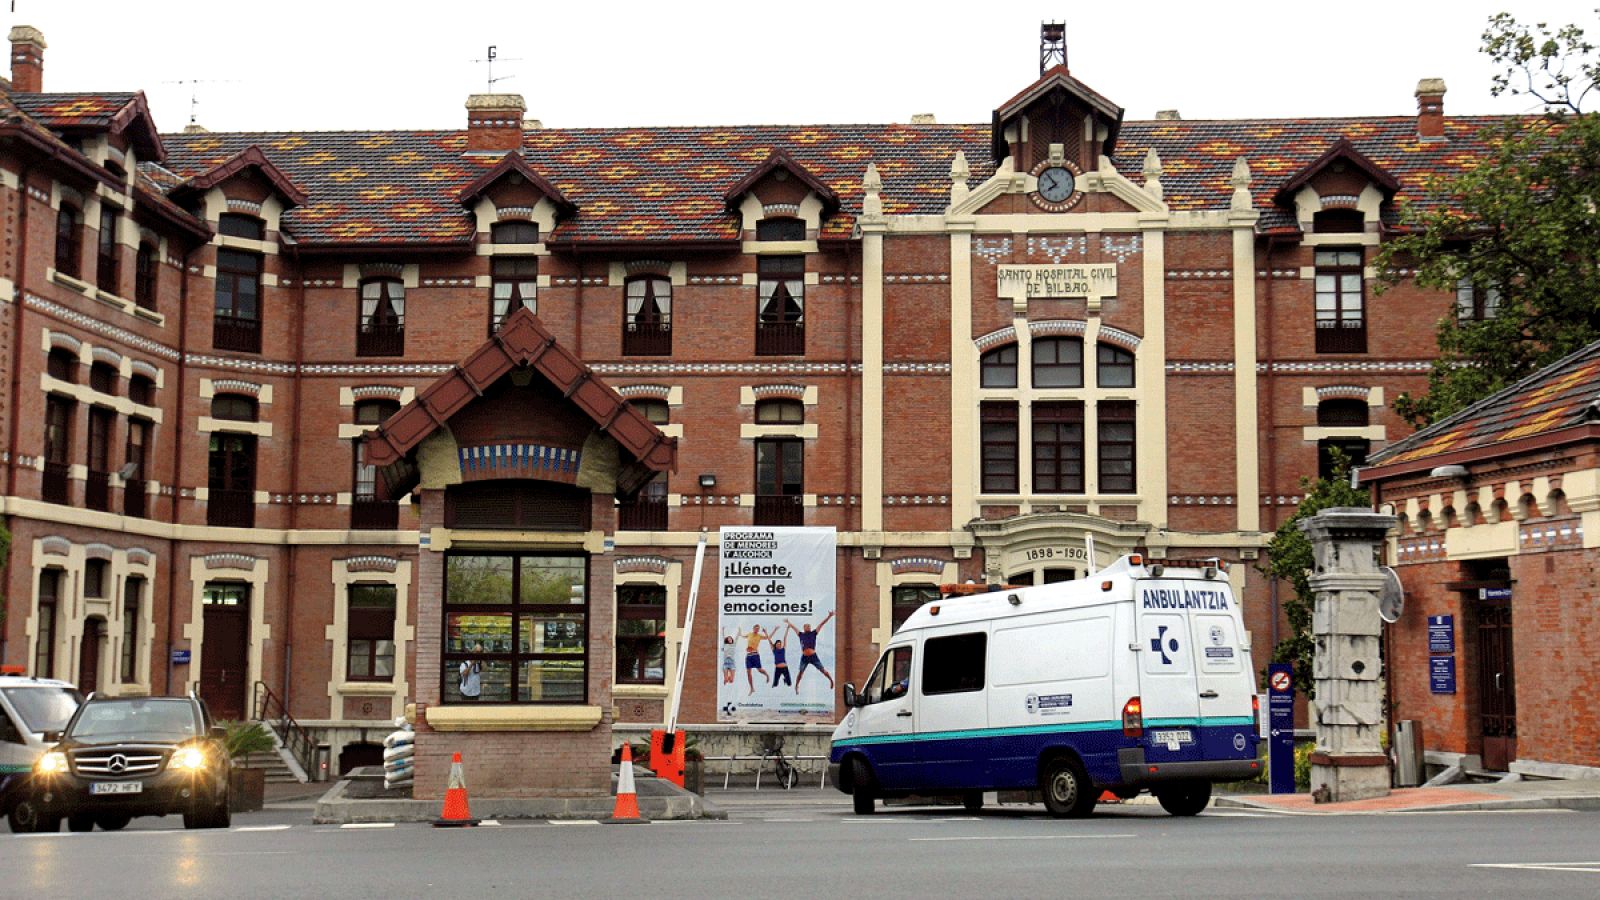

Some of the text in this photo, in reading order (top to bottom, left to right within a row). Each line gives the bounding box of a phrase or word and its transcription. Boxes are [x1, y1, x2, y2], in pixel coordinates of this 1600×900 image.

[998, 268, 1117, 280] SANTO HOSPITAL CIVIL
[1026, 282, 1092, 294] DE BILBAO.
[724, 532, 773, 540] PROGRAMA
[724, 541, 777, 549] DE MENORES
[724, 561, 792, 578] ¡Llénate,
[724, 580, 786, 597] pero de
[1143, 589, 1229, 610] ANBULANTZIA
[724, 599, 813, 613] emociones!
[96, 783, 119, 793] 3472
